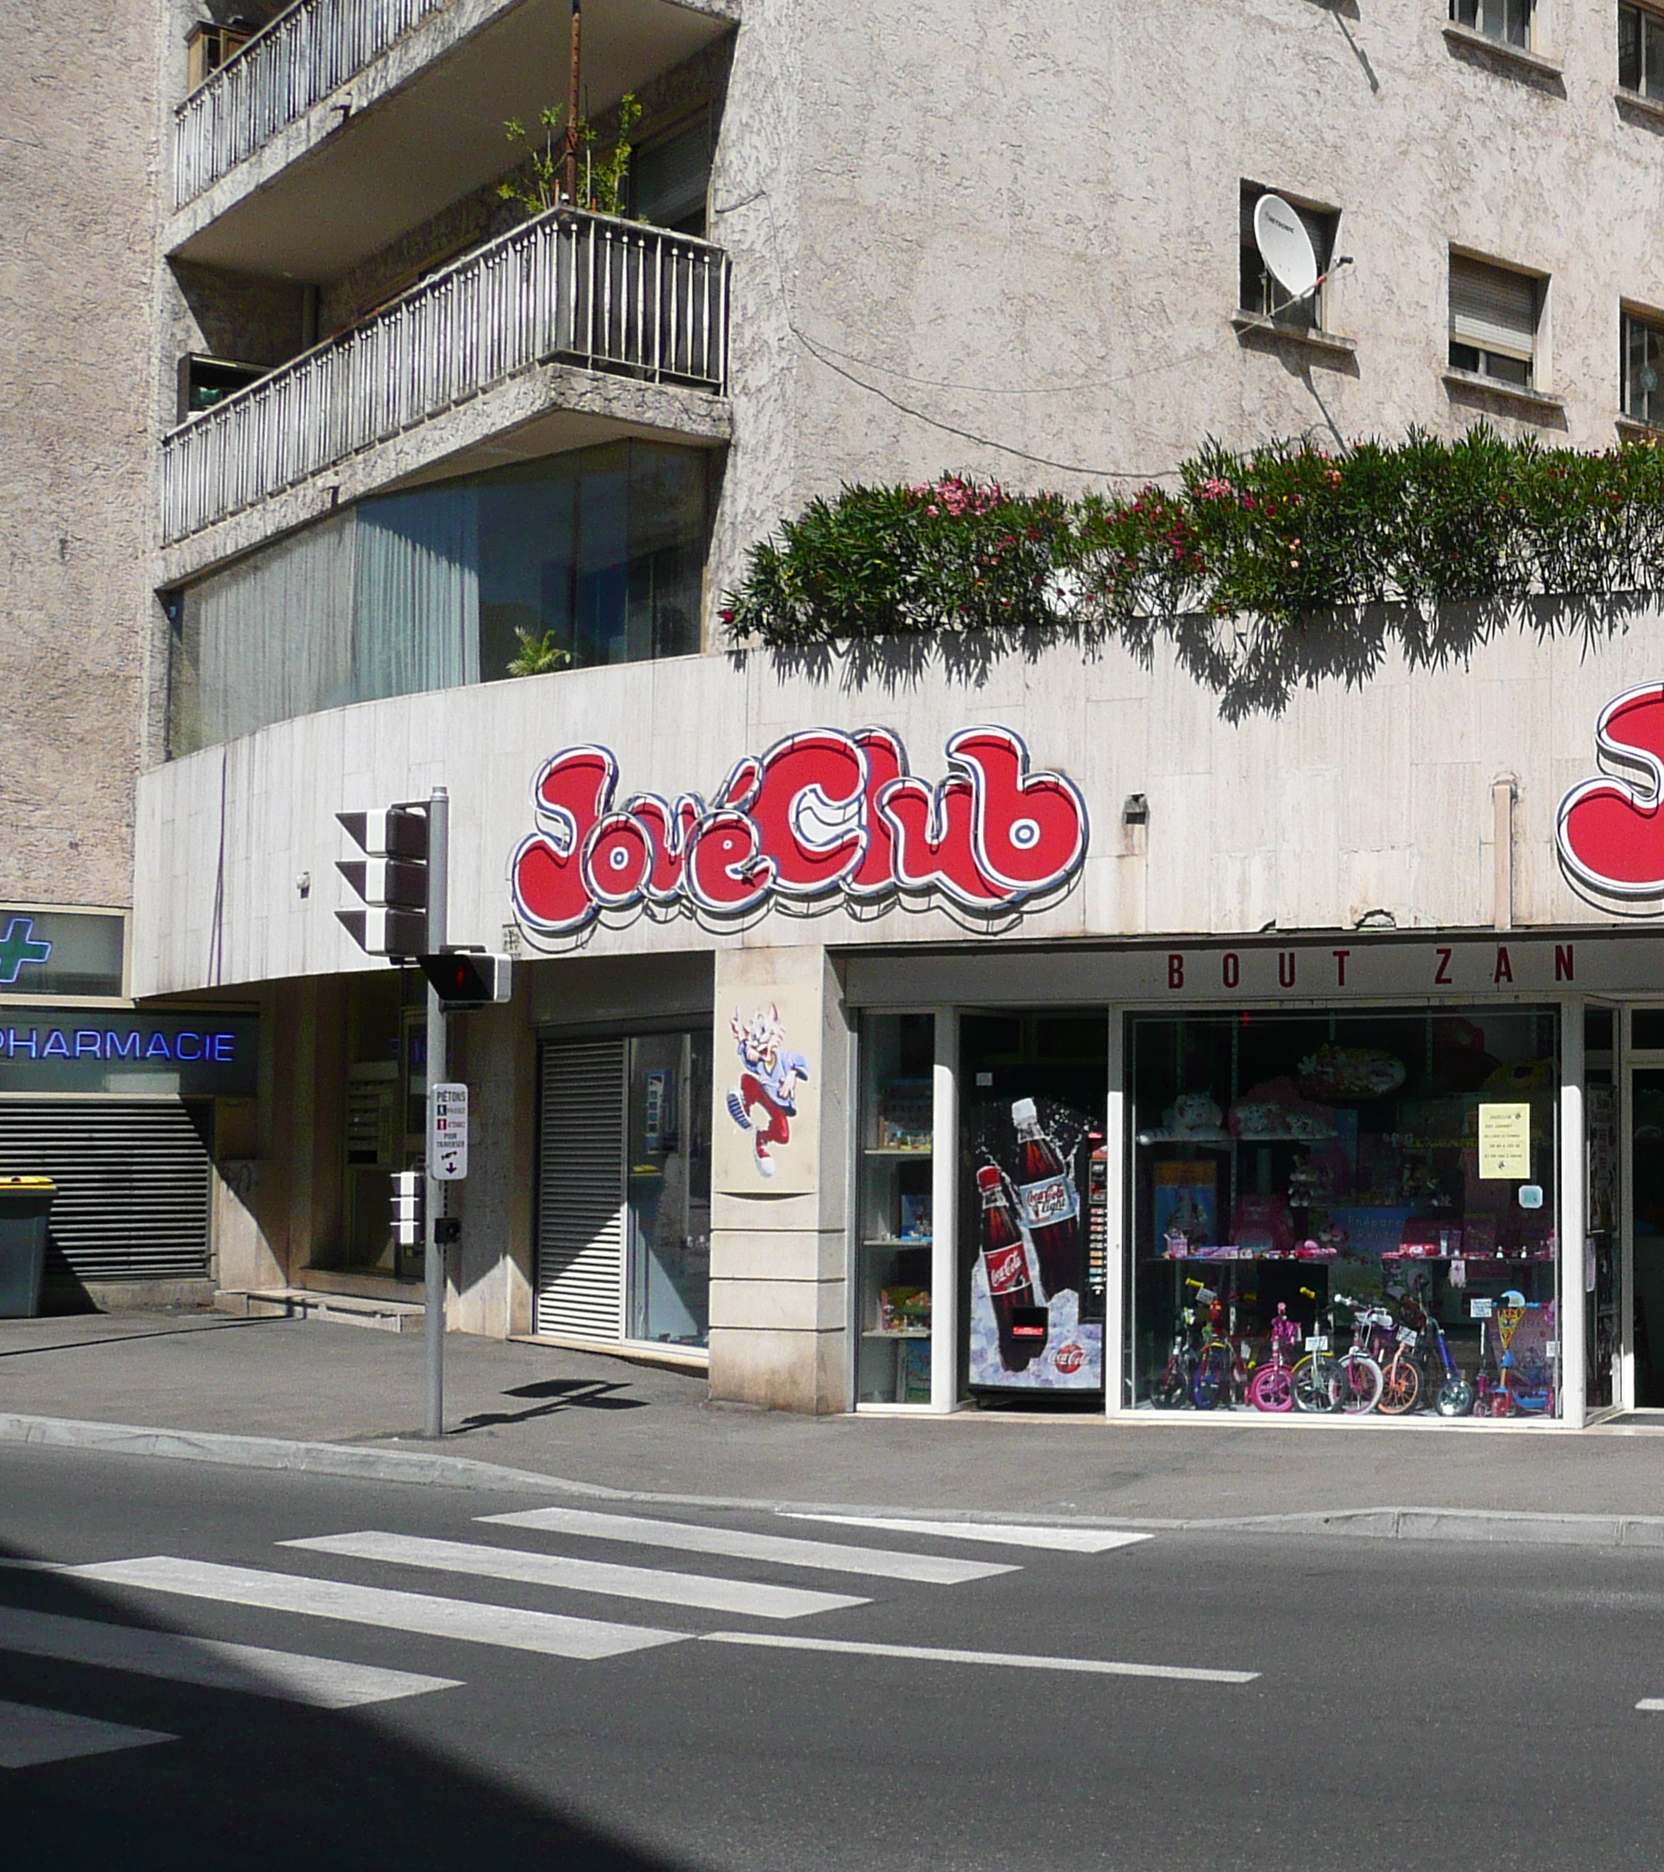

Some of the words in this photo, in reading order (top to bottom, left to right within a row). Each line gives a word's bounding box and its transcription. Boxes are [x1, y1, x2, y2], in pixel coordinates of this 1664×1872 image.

[1167, 949, 1351, 989] BOUT
[1434, 944, 1575, 985] ZAN
[0, 1027, 236, 1062] HARMACIE
